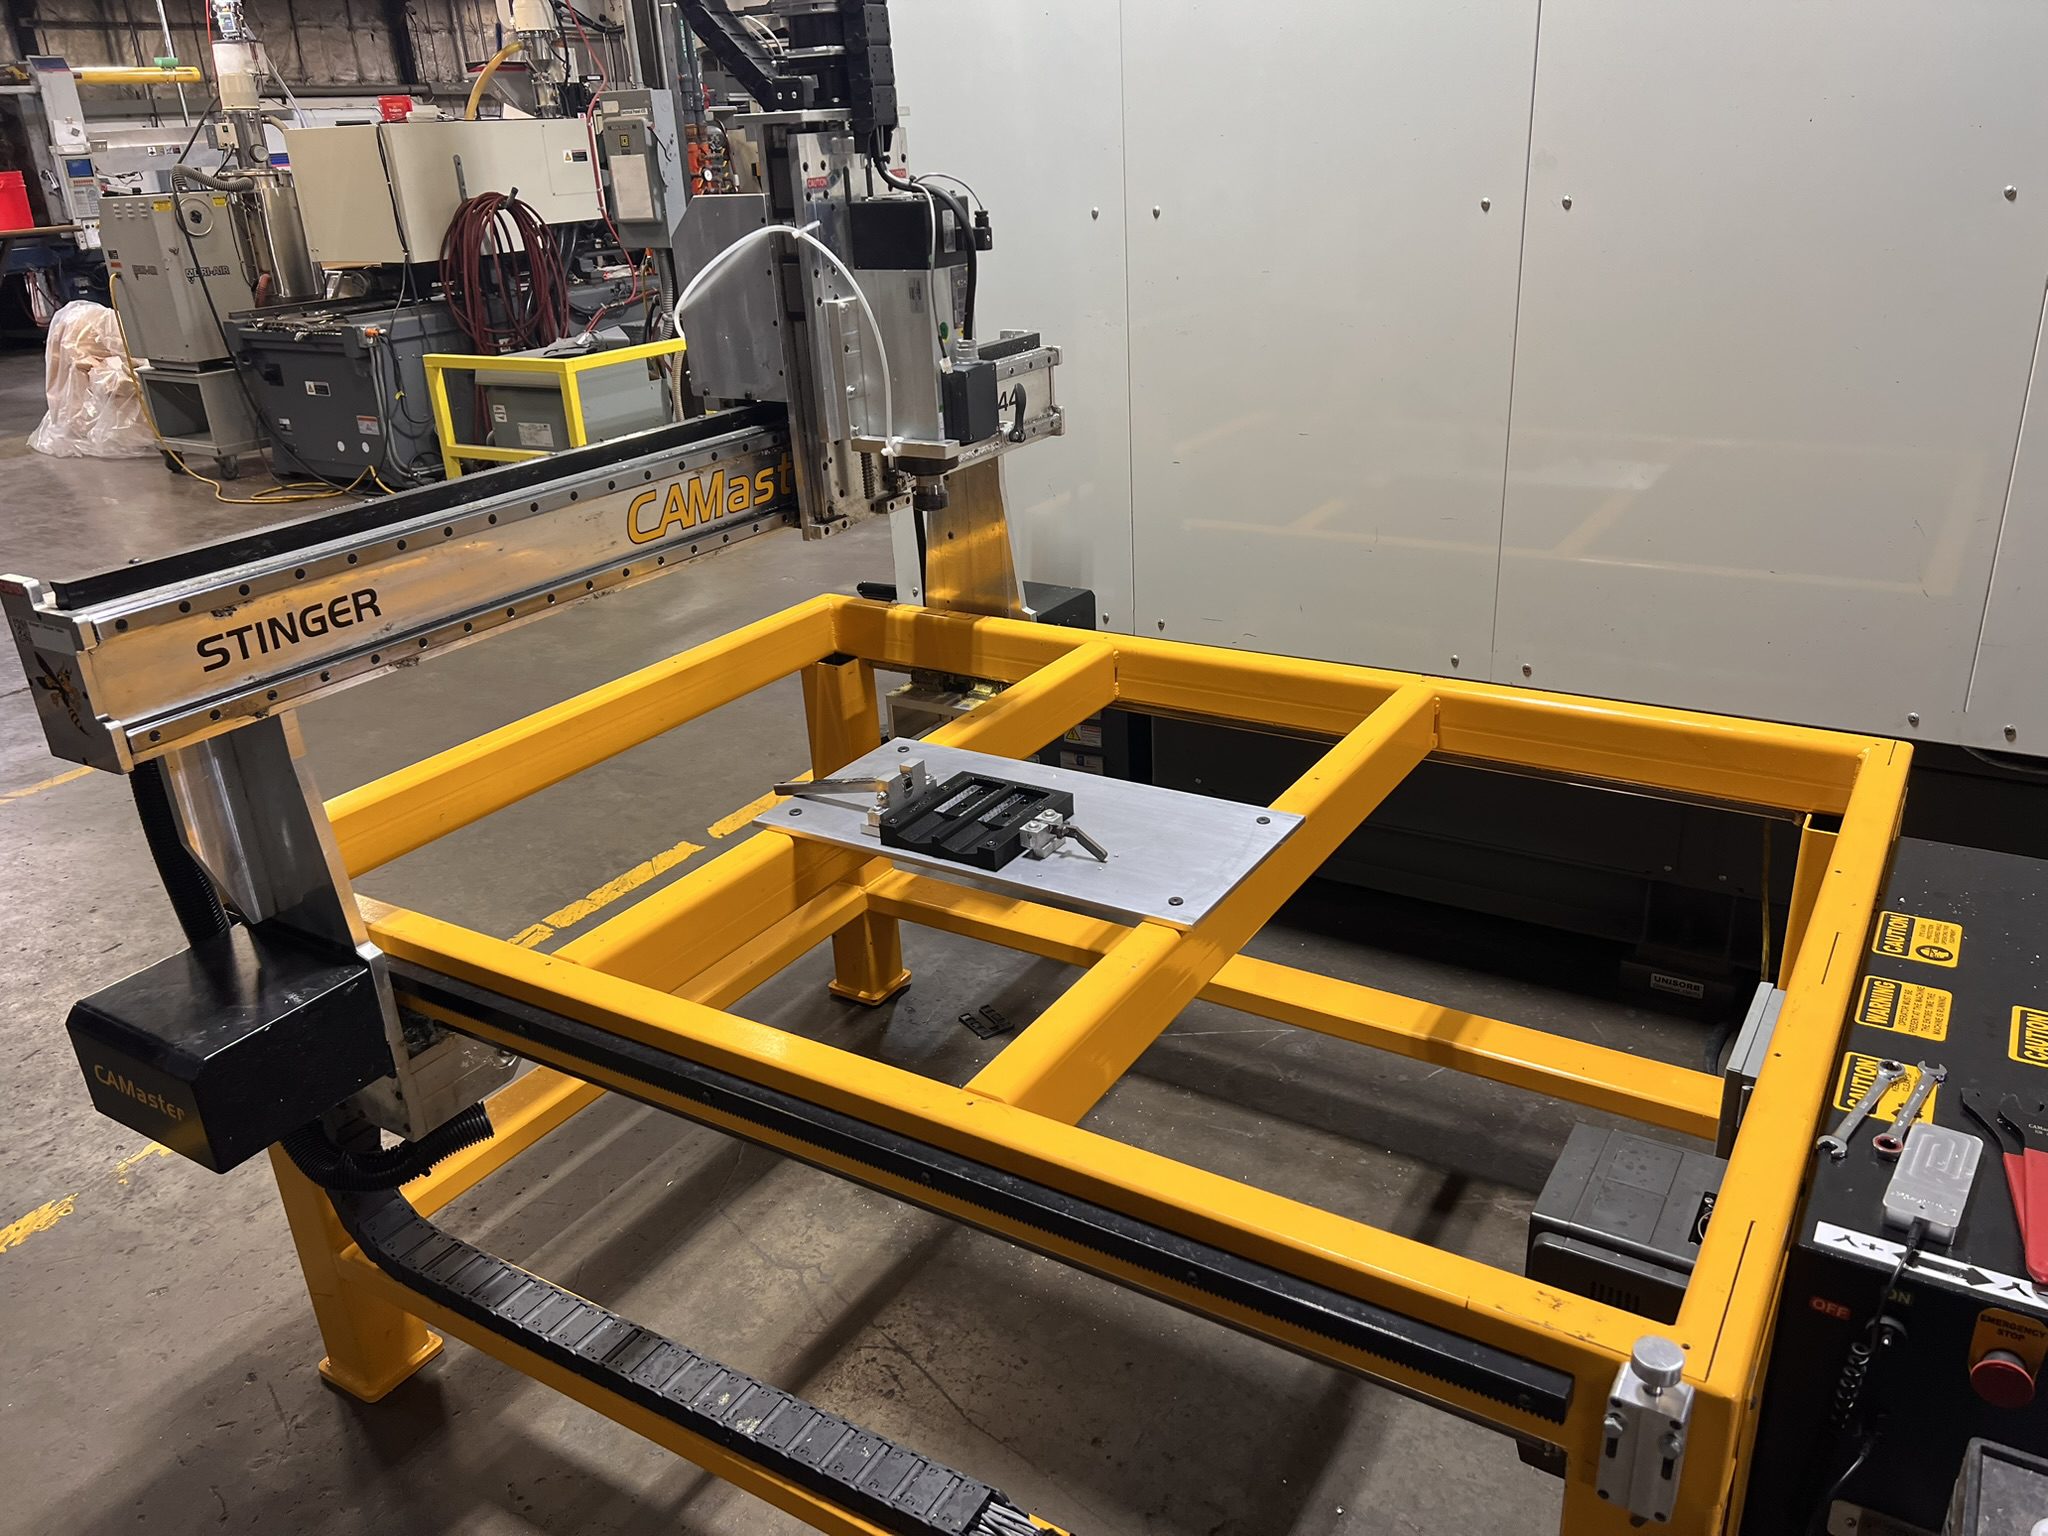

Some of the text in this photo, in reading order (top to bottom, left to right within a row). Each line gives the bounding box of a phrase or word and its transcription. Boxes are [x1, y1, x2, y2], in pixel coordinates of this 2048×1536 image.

[627, 451, 794, 545] CAMast
[196, 588, 382, 673] STINGER
[1883, 915, 1909, 953] CAUTION
[1654, 975, 1700, 992] UNISORB
[1865, 980, 1896, 1024] WARNING
[2023, 1012, 2048, 1062] CAUTION
[94, 1064, 185, 1121] CAMaster
[1811, 1298, 1850, 1317] OFF
[1980, 1314, 2047, 1338] EMERGENCY
[1996, 1328, 2025, 1341] STOP
